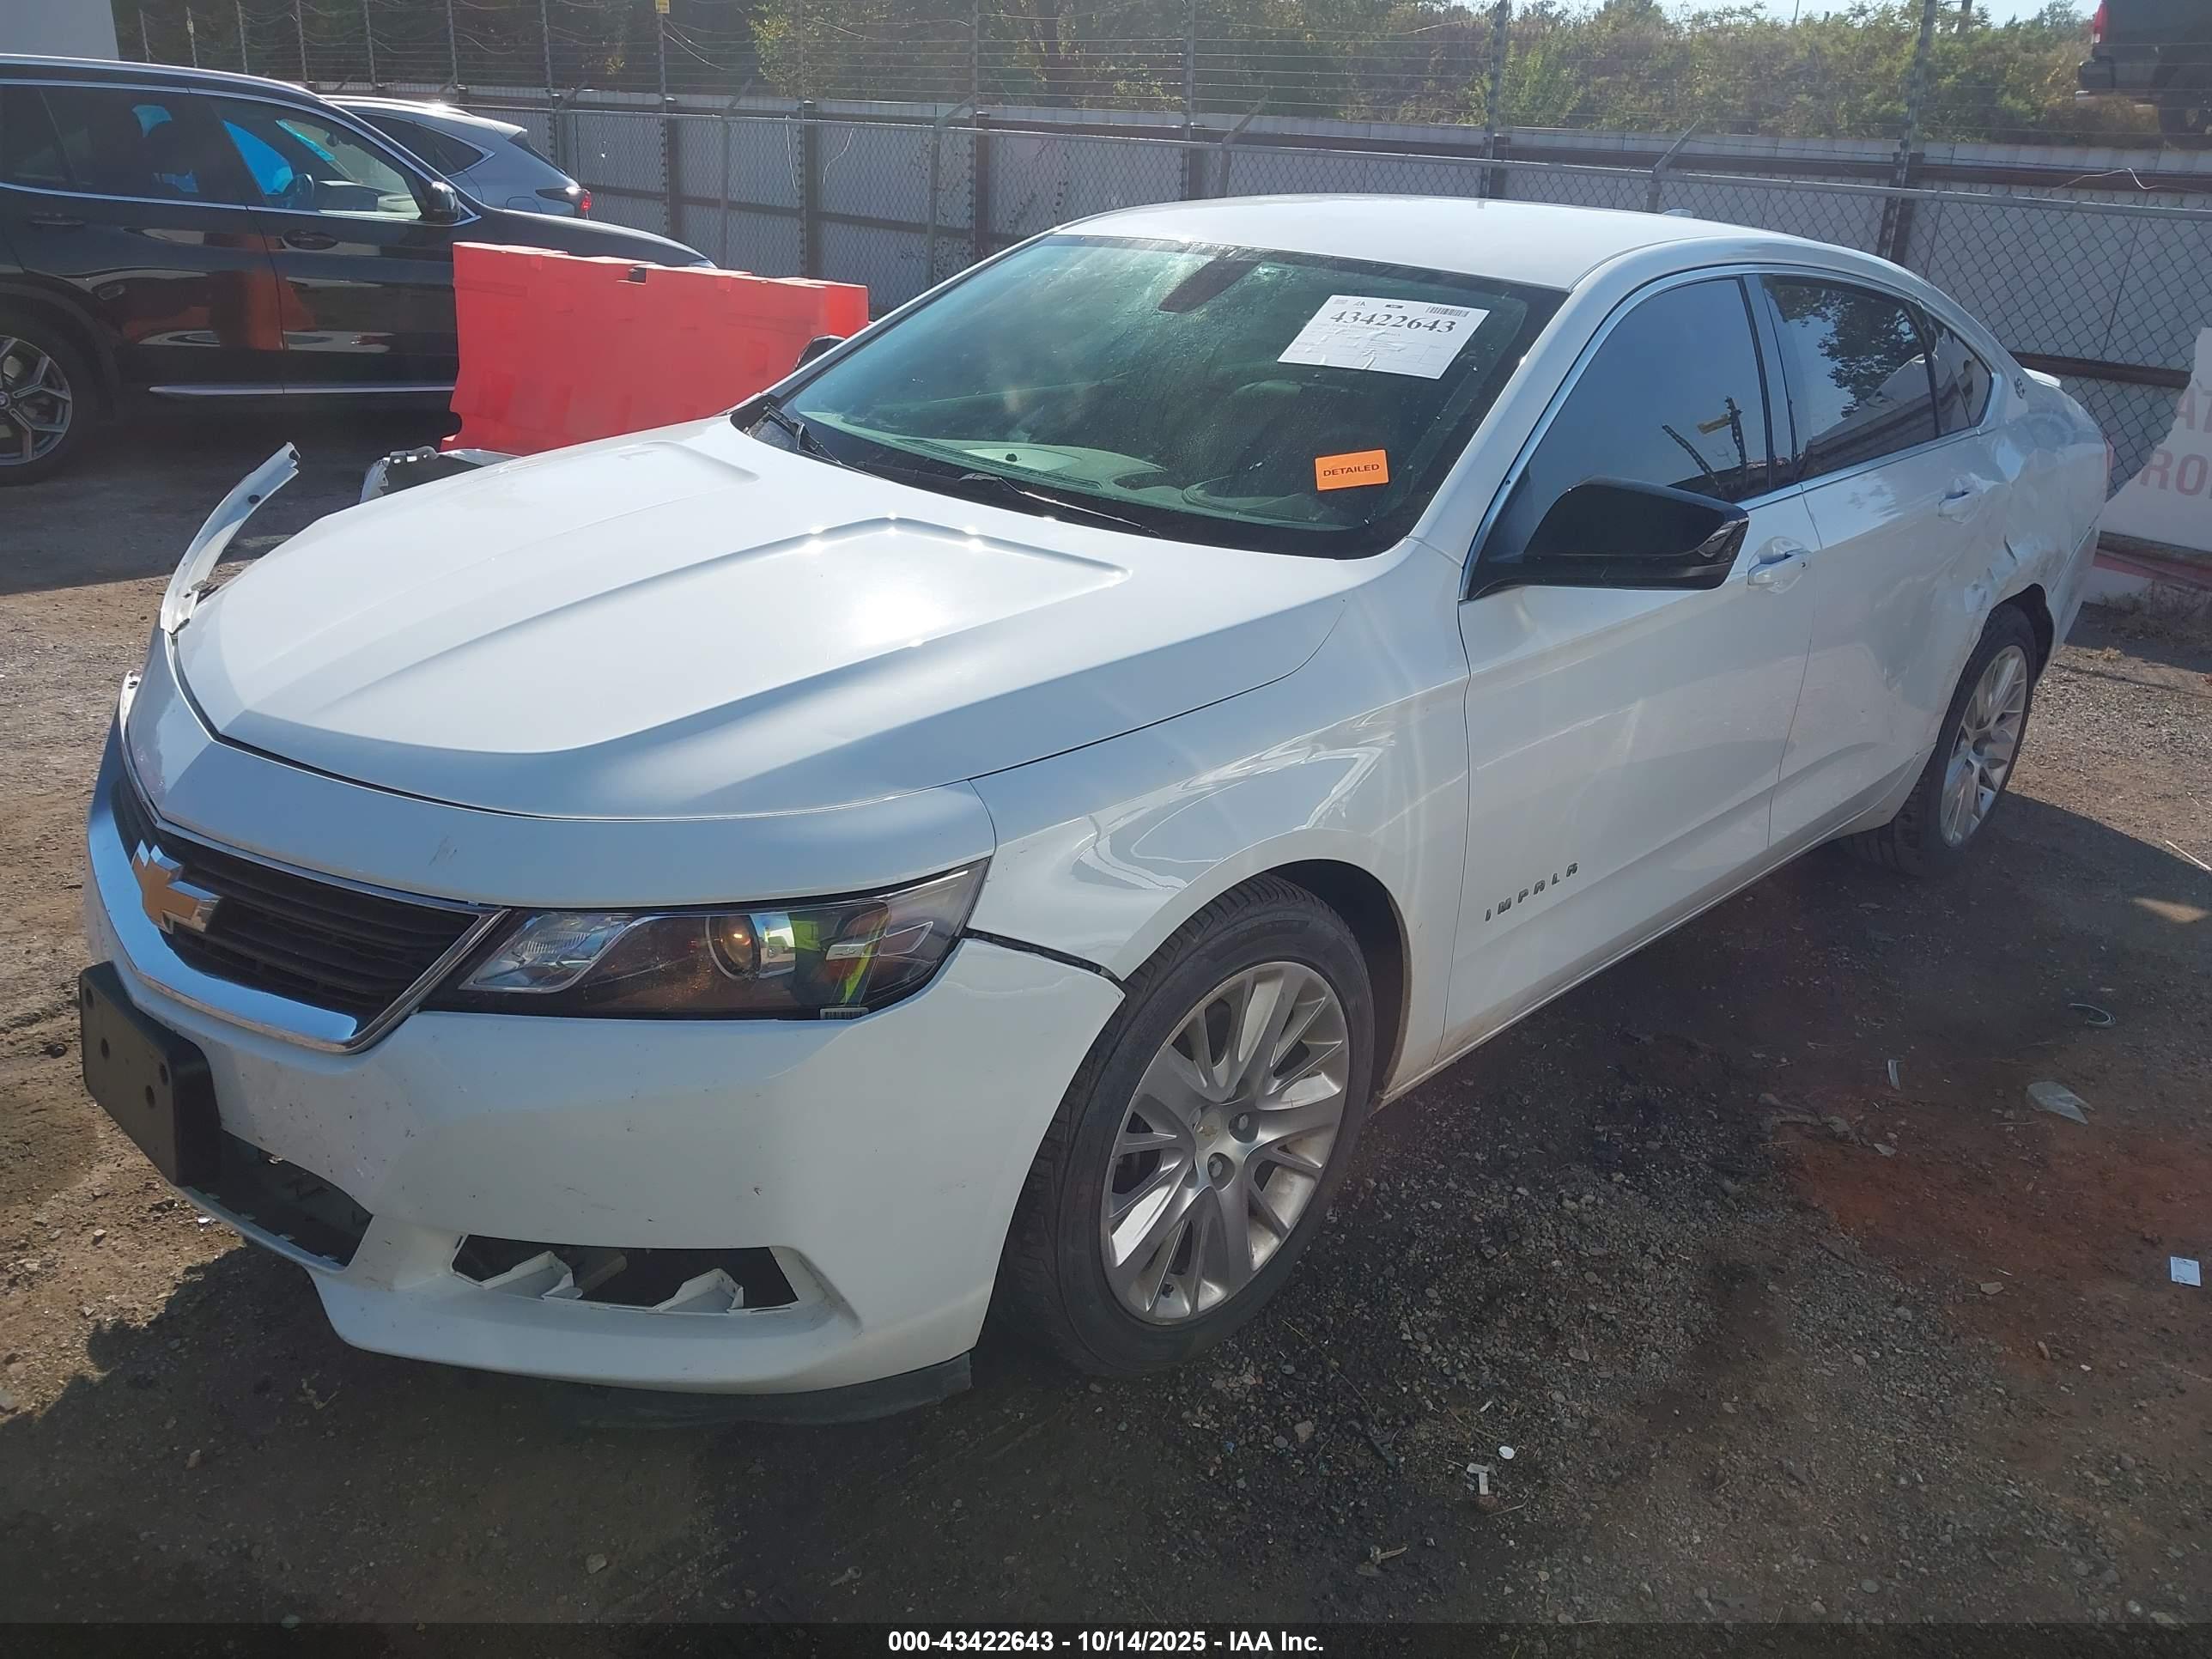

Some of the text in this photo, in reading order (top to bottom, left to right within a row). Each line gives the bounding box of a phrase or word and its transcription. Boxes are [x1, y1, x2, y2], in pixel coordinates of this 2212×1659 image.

[1329, 310, 1456, 333] 43422643
[1323, 464, 1380, 477] DETAILED
[2140, 447, 2212, 499] RO
[1485, 862, 1578, 921] IMPALA
